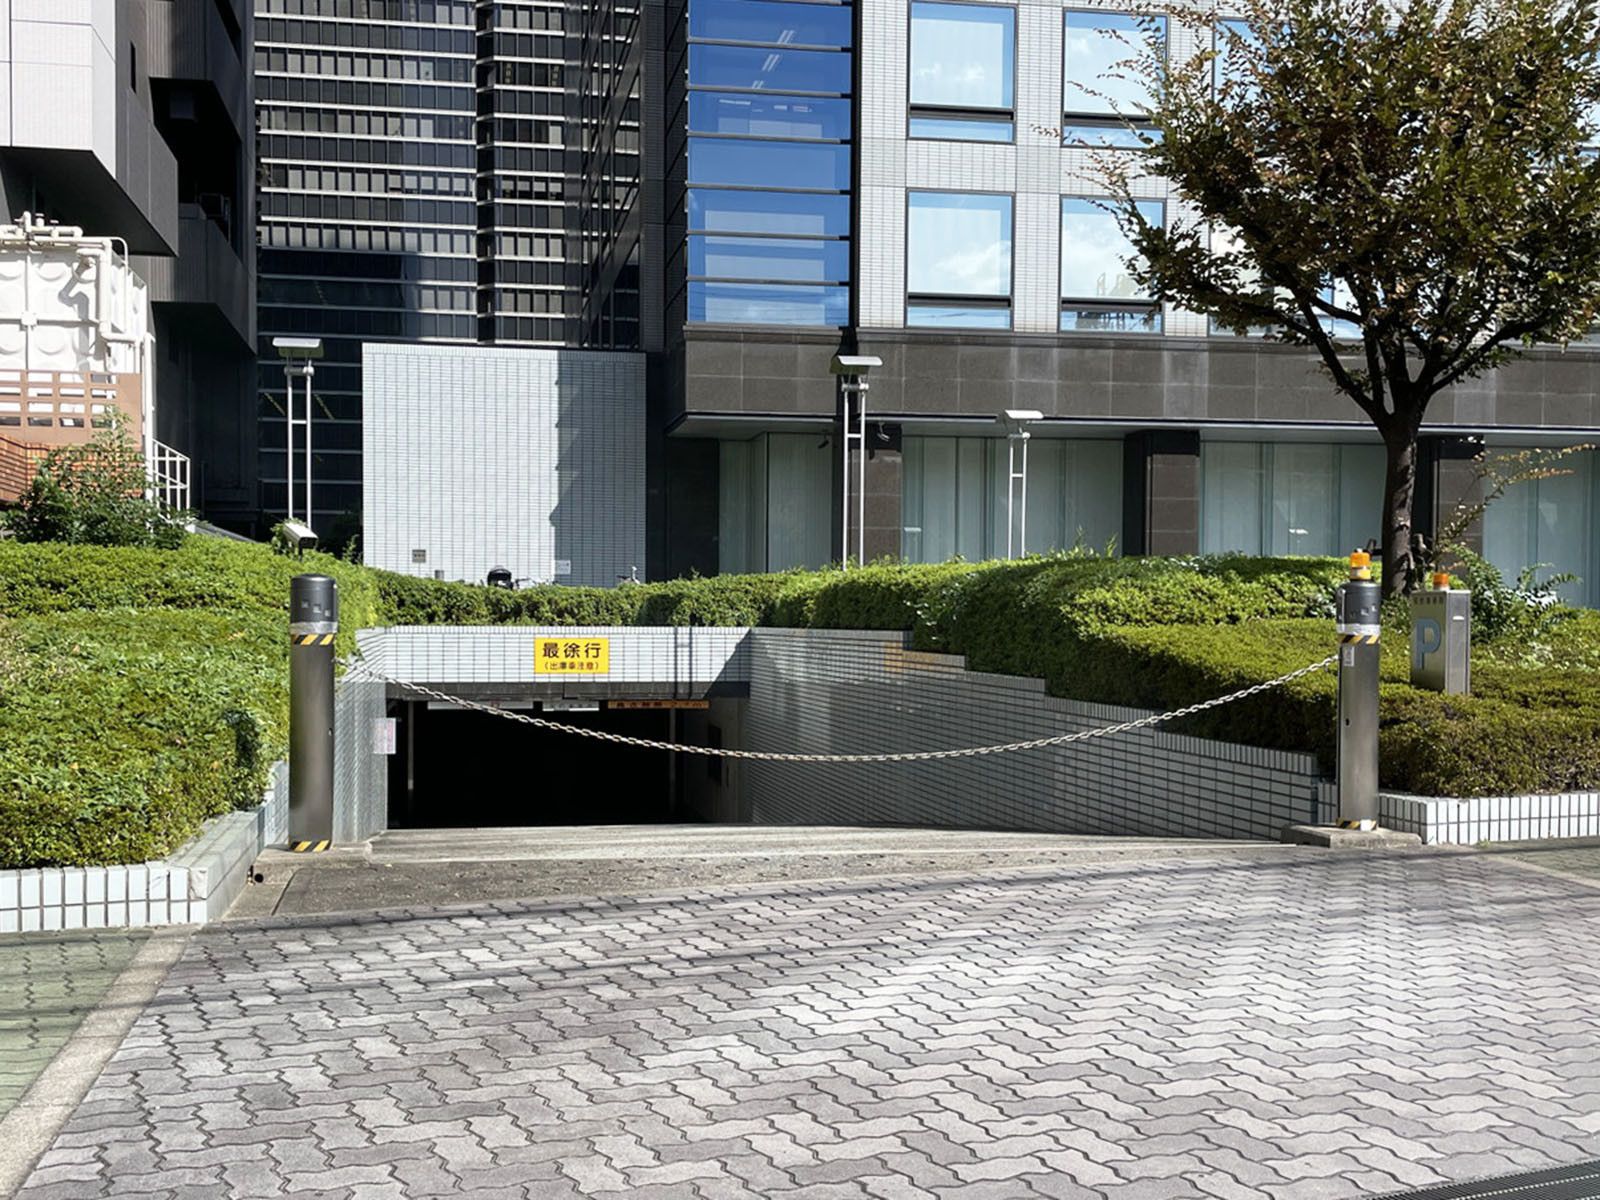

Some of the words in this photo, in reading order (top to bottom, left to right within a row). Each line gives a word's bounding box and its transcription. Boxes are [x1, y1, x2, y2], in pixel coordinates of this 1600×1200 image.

[543, 642, 602, 659] 最徐行
[1415, 617, 1441, 670] P
